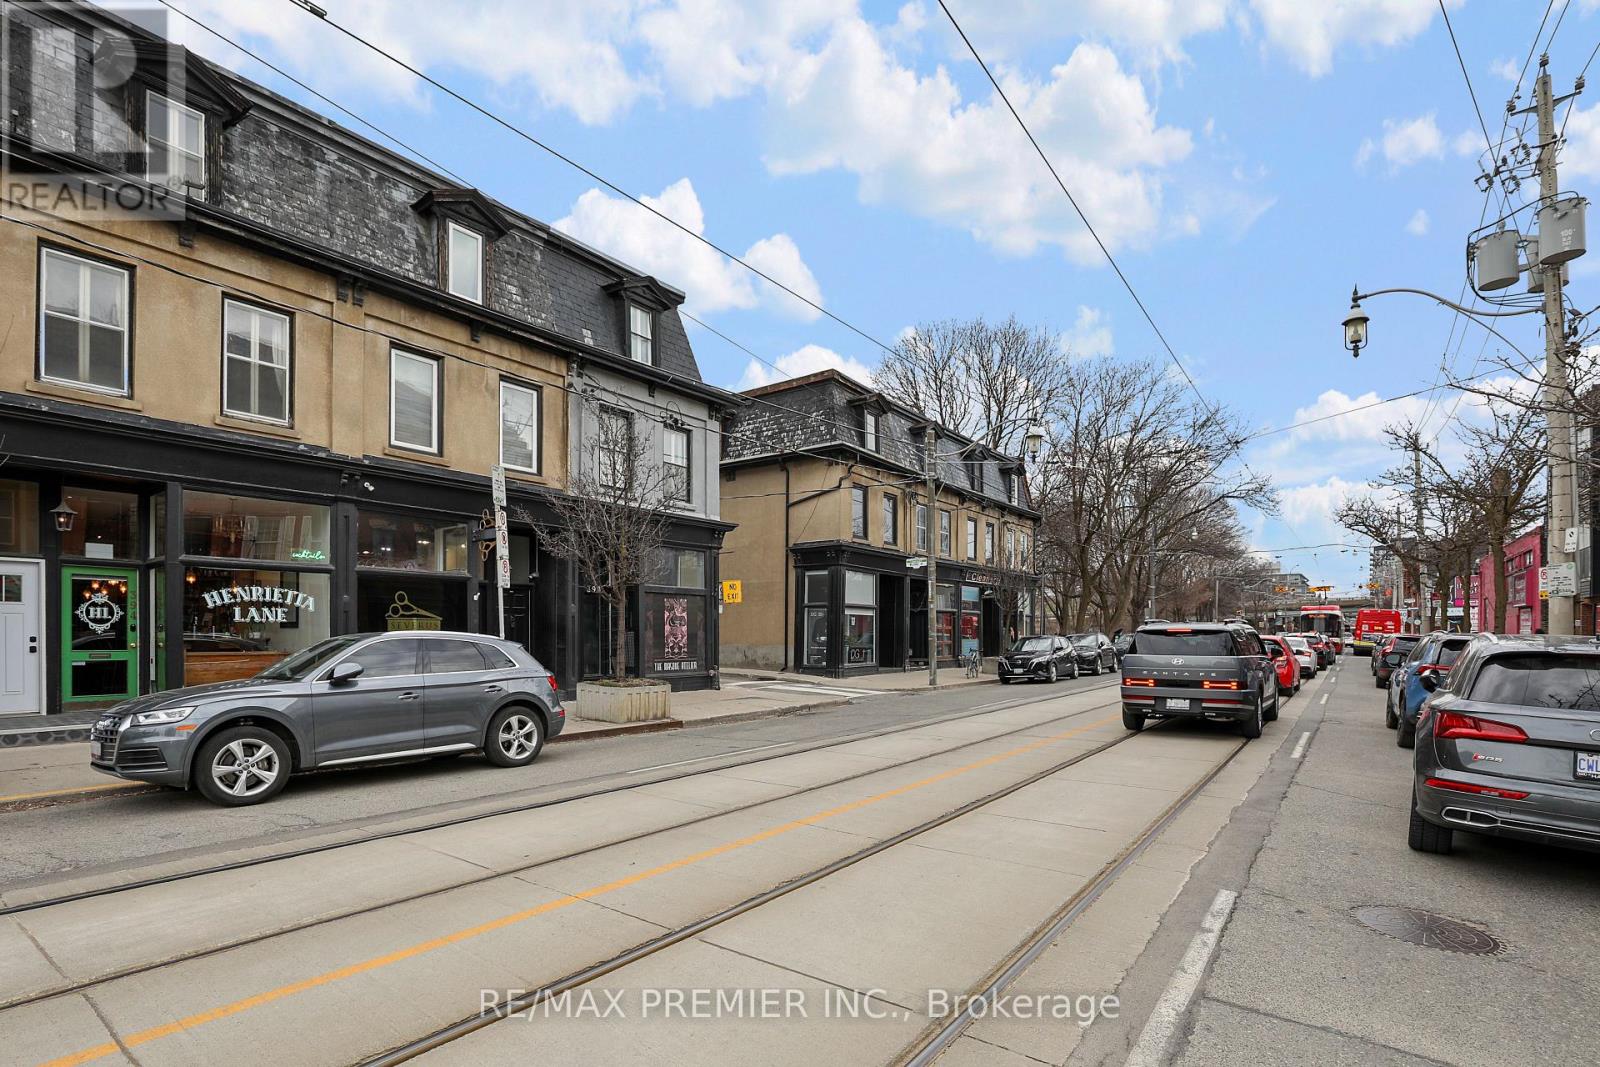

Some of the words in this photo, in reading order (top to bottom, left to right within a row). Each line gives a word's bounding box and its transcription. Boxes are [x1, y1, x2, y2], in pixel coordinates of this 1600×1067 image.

[729, 583, 737, 591] NO
[201, 584, 315, 612] HENRIETTA
[727, 592, 739, 600] EXIT
[232, 605, 288, 623] LANE
